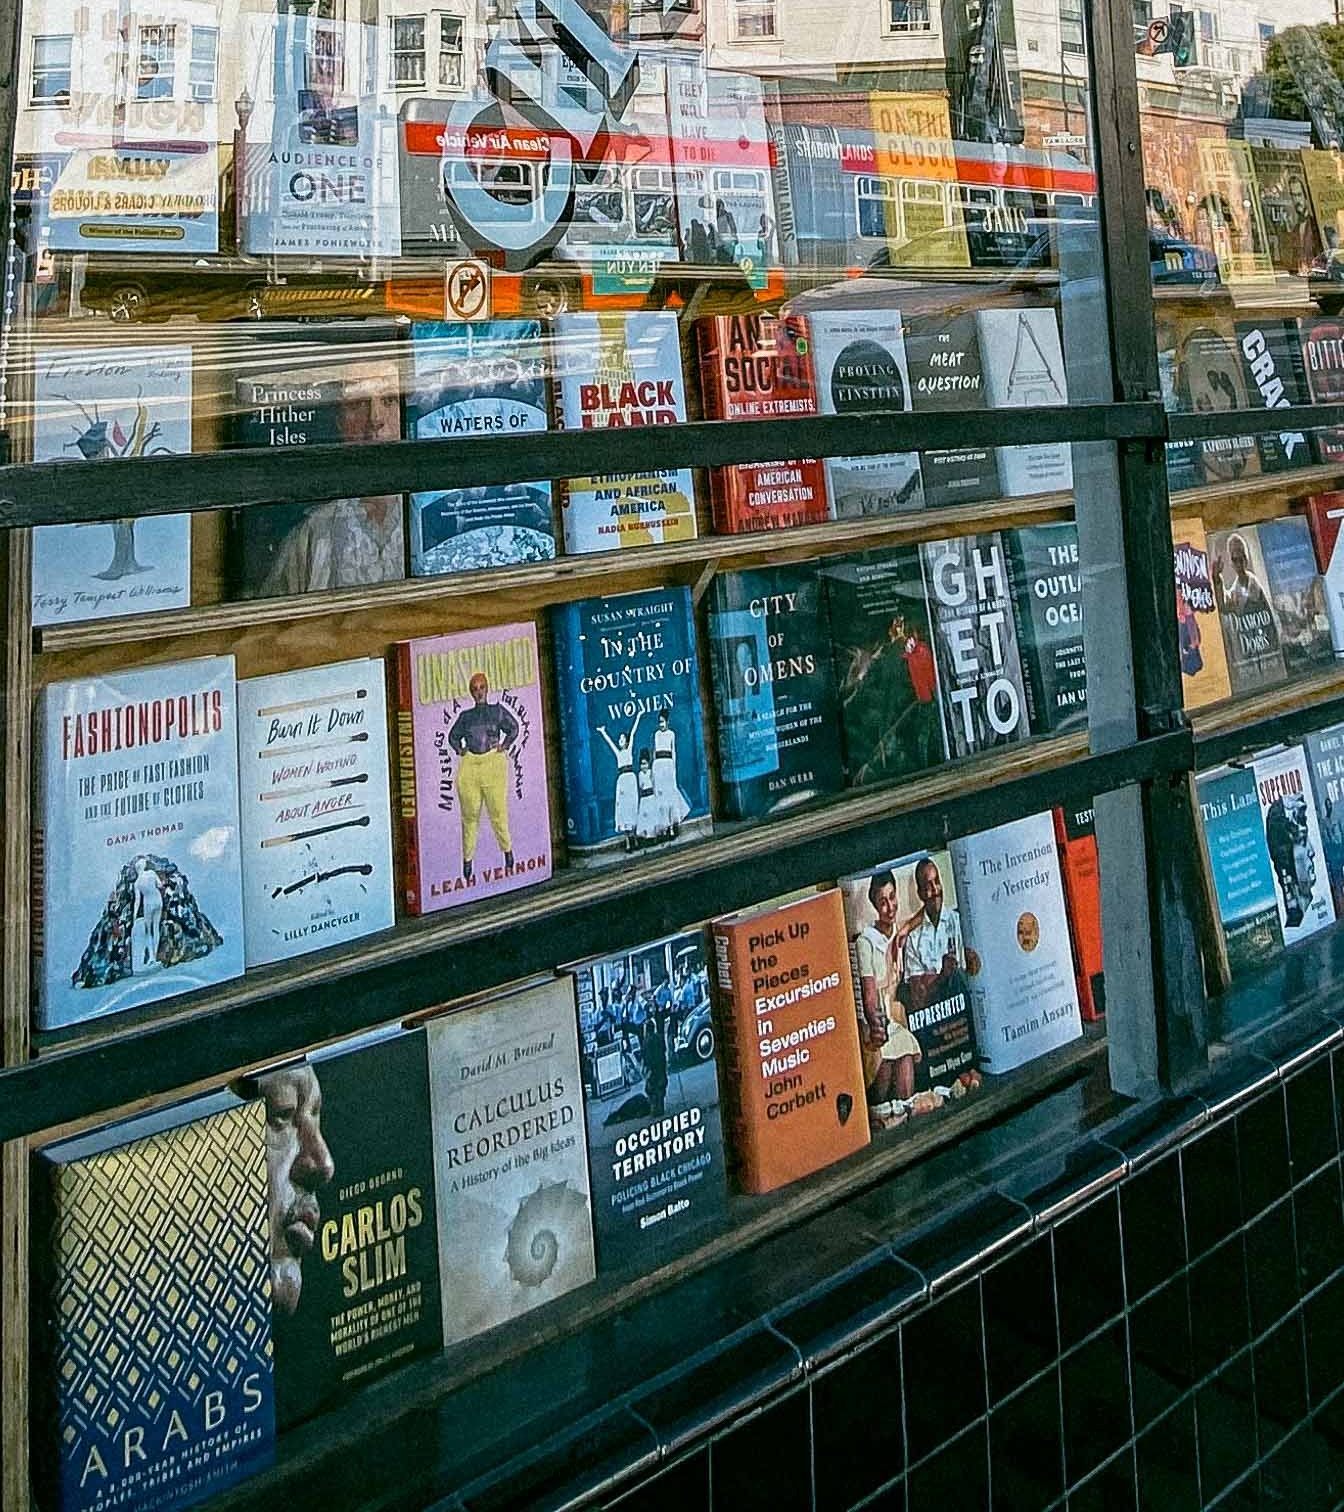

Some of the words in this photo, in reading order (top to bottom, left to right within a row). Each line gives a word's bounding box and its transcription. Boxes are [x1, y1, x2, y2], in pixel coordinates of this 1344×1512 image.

[268, 151, 356, 169] AUDIENCE
[795, 140, 875, 162] SHADOWLANDS
[887, 138, 955, 169] CLOCK
[289, 170, 366, 204] ONE
[982, 206, 1029, 234] JANIS
[274, 237, 310, 248] JAMES
[839, 363, 895, 379] PROVING
[929, 351, 965, 367] MEAT
[251, 384, 322, 403] Princess
[579, 379, 677, 412] BLACK
[838, 387, 901, 402] EINSTEIN
[918, 374, 982, 395] QUESTION
[257, 405, 316, 425] Hither
[728, 401, 761, 416] ONLINE
[269, 427, 307, 446] Isles
[440, 416, 504, 433] WATERS
[509, 414, 529, 428] OF
[757, 468, 803, 487] AMERICAN
[594, 486, 624, 502] AND
[625, 482, 678, 501] AFRICAN
[748, 486, 814, 507] CONVERSATION
[610, 499, 667, 518] AMERICA
[1047, 544, 1080, 567] THE
[1034, 574, 1082, 599] OUTL
[591, 610, 623, 625] SUSAN
[749, 592, 798, 619] CITY
[1045, 602, 1083, 626] OCE
[600, 637, 624, 658] IN
[627, 631, 664, 656] THE
[767, 632, 785, 648] OF
[580, 663, 666, 694] COUNTRY
[672, 657, 693, 676] OF
[743, 654, 816, 687] OMENS
[607, 692, 675, 720] WOMEN
[1057, 691, 1076, 706] IAN
[62, 689, 223, 762] FASHIONOPOLIS
[266, 718, 303, 745] Burn
[307, 712, 322, 737] It
[327, 707, 365, 733] Down
[79, 775, 96, 799] THE
[100, 769, 130, 792] PRICE
[143, 760, 167, 785] FAST
[168, 753, 211, 780] FASHION
[271, 760, 312, 785] WOMEN
[315, 753, 358, 778] WRITING
[1316, 759, 1332, 779] THE
[768, 777, 787, 792] DAN
[1258, 768, 1303, 807] SUPERIOR
[1326, 780, 1340, 802] OF
[114, 792, 150, 818] FUTURE
[163, 780, 206, 808] CLOTHES
[275, 803, 311, 823] ABOUT
[311, 792, 354, 816] ANGER
[1199, 799, 1228, 822] This
[1230, 788, 1257, 813] Land
[106, 831, 137, 848] DANA
[140, 821, 185, 839] THOMAS
[978, 859, 1003, 877] The
[1005, 842, 1054, 867] Invention
[430, 873, 477, 898] LEAH
[482, 854, 547, 884] VERNON
[991, 888, 1002, 905] of
[1002, 870, 1051, 898] Yesterday
[284, 925, 309, 942] LILLY
[310, 911, 362, 934] DANCYGER
[748, 931, 785, 954] Pick
[788, 920, 811, 941] Up
[750, 953, 779, 974] the
[752, 963, 811, 995] Pieces
[754, 971, 841, 1016] Excursions
[908, 992, 967, 1033] REPRESENTED
[1001, 1015, 1040, 1043] Tamim
[1041, 1001, 1075, 1027] Ansary
[757, 1018, 773, 1037] in
[759, 1015, 836, 1059] Seventies
[459, 1055, 493, 1081] David
[494, 1054, 510, 1070] M.
[761, 1047, 811, 1080] Music
[764, 1073, 803, 1100] John
[453, 1077, 565, 1134] CALCULUS
[766, 1081, 827, 1121] Corbett
[445, 1104, 575, 1171] REORDERED
[615, 1107, 702, 1157] OCCUPIED
[450, 1179, 459, 1194] A
[461, 1165, 500, 1190] History
[501, 1158, 513, 1173] of
[514, 1151, 530, 1169] the
[532, 1144, 550, 1161] Big
[550, 1135, 576, 1154] Ideas
[612, 1125, 706, 1182] TERRITORY
[339, 1179, 366, 1201] DIEGO
[610, 1179, 650, 1207] POLICING
[650, 1167, 677, 1188] BLACK
[677, 1151, 712, 1176] CHICAGO
[321, 1187, 423, 1262] CARLOS
[640, 1209, 667, 1229] Simon
[342, 1235, 407, 1298] SLIM
[330, 1311, 346, 1329] THE
[346, 1300, 374, 1322] POWER,
[330, 1320, 369, 1345] MORALITY
[78, 1371, 264, 1489] ARABS
[180, 1429, 230, 1460] HISTORY
[234, 1420, 249, 1435] OF
[142, 1465, 182, 1490] TRIBES
[186, 1451, 211, 1471] AND
[215, 1426, 264, 1458] EMPIRES
